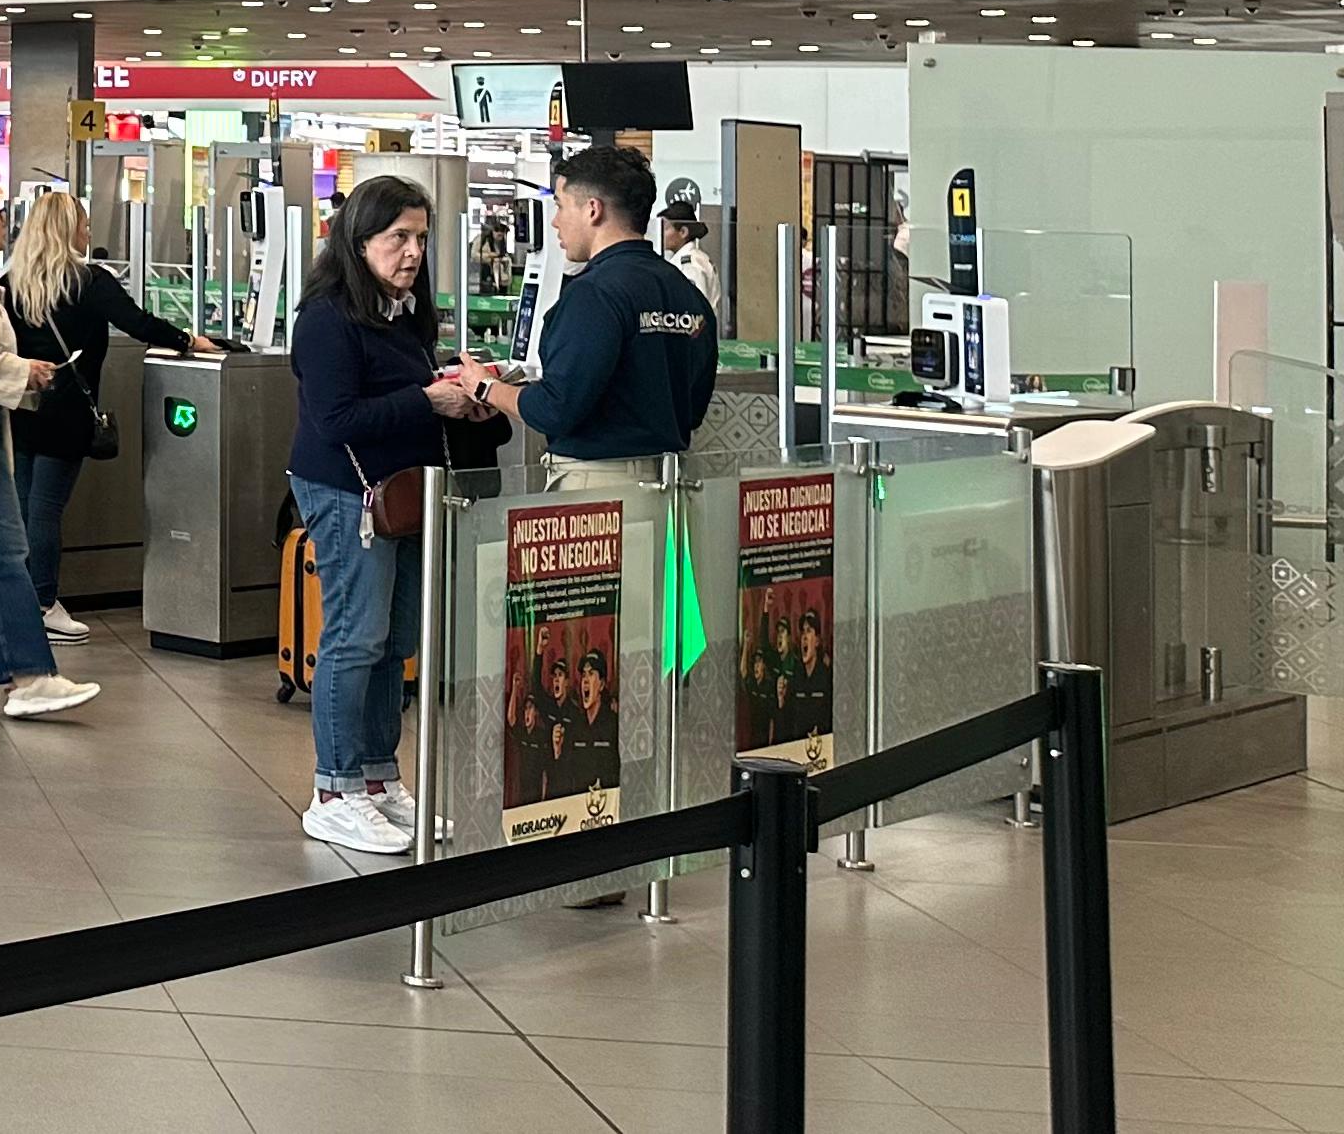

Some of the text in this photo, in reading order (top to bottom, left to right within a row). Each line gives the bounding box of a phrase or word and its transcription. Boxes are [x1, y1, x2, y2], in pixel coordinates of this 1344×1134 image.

[251, 70, 317, 87] DUFRY
[80, 110, 96, 132] 4
[552, 104, 558, 121] 2
[959, 193, 966, 212] 1
[744, 484, 832, 517] ¡NUESTRA DIGNIDAD
[514, 512, 620, 548] ¡NUESTRA DIGNIDAD
[750, 516, 764, 540] NO
[767, 514, 779, 538] SE
[521, 547, 538, 574] NO
[541, 545, 555, 572] SE
[512, 814, 563, 837] MIGRACIÓN
